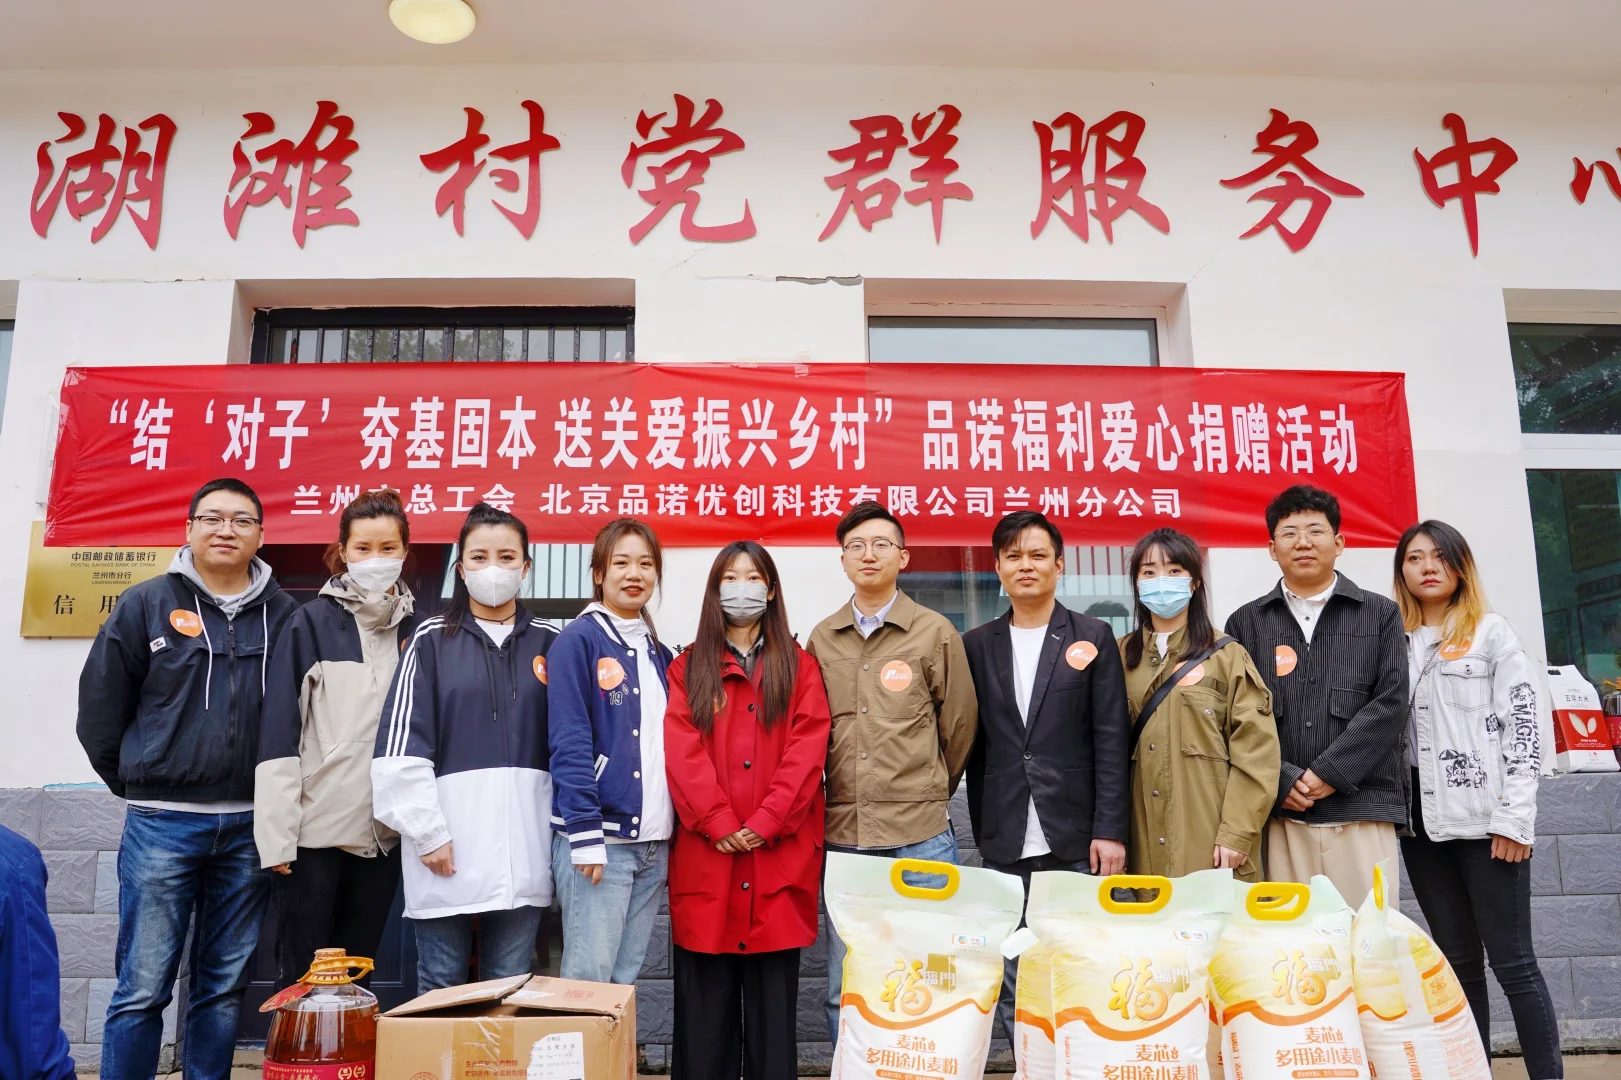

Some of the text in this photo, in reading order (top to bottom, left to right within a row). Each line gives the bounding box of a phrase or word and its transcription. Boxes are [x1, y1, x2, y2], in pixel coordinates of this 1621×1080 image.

[922, 397, 1358, 474] 品诺福利爱心捐赠活动
[290, 483, 516, 515] 兰州总工会
[71, 551, 157, 562] 中国邮政储蓄银行
[92, 571, 132, 580] 兰州市分行
[866, 1047, 959, 1075] 多用途小麦粉
[1275, 1046, 1363, 1067] 多用途小麦粉
